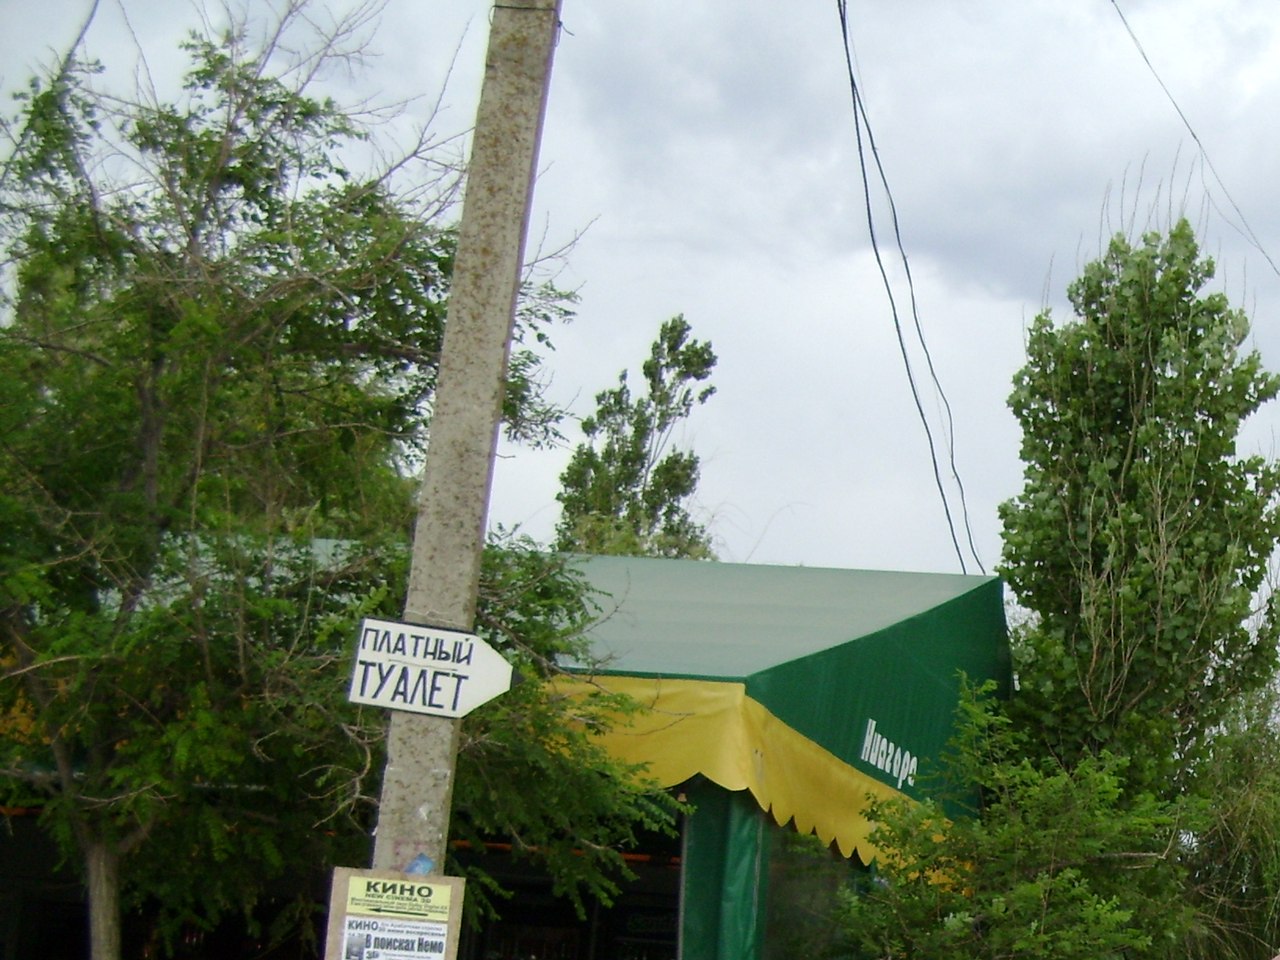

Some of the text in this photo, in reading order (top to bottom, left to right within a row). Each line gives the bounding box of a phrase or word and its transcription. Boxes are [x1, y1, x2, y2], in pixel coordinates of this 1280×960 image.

[361, 627, 474, 665] ПЛАТНЫЙ
[358, 660, 469, 711] ТУАЛЕТ
[365, 880, 433, 898] КИНО
[347, 920, 379, 931] КИНО
[365, 933, 444, 954] В поисках Немо
